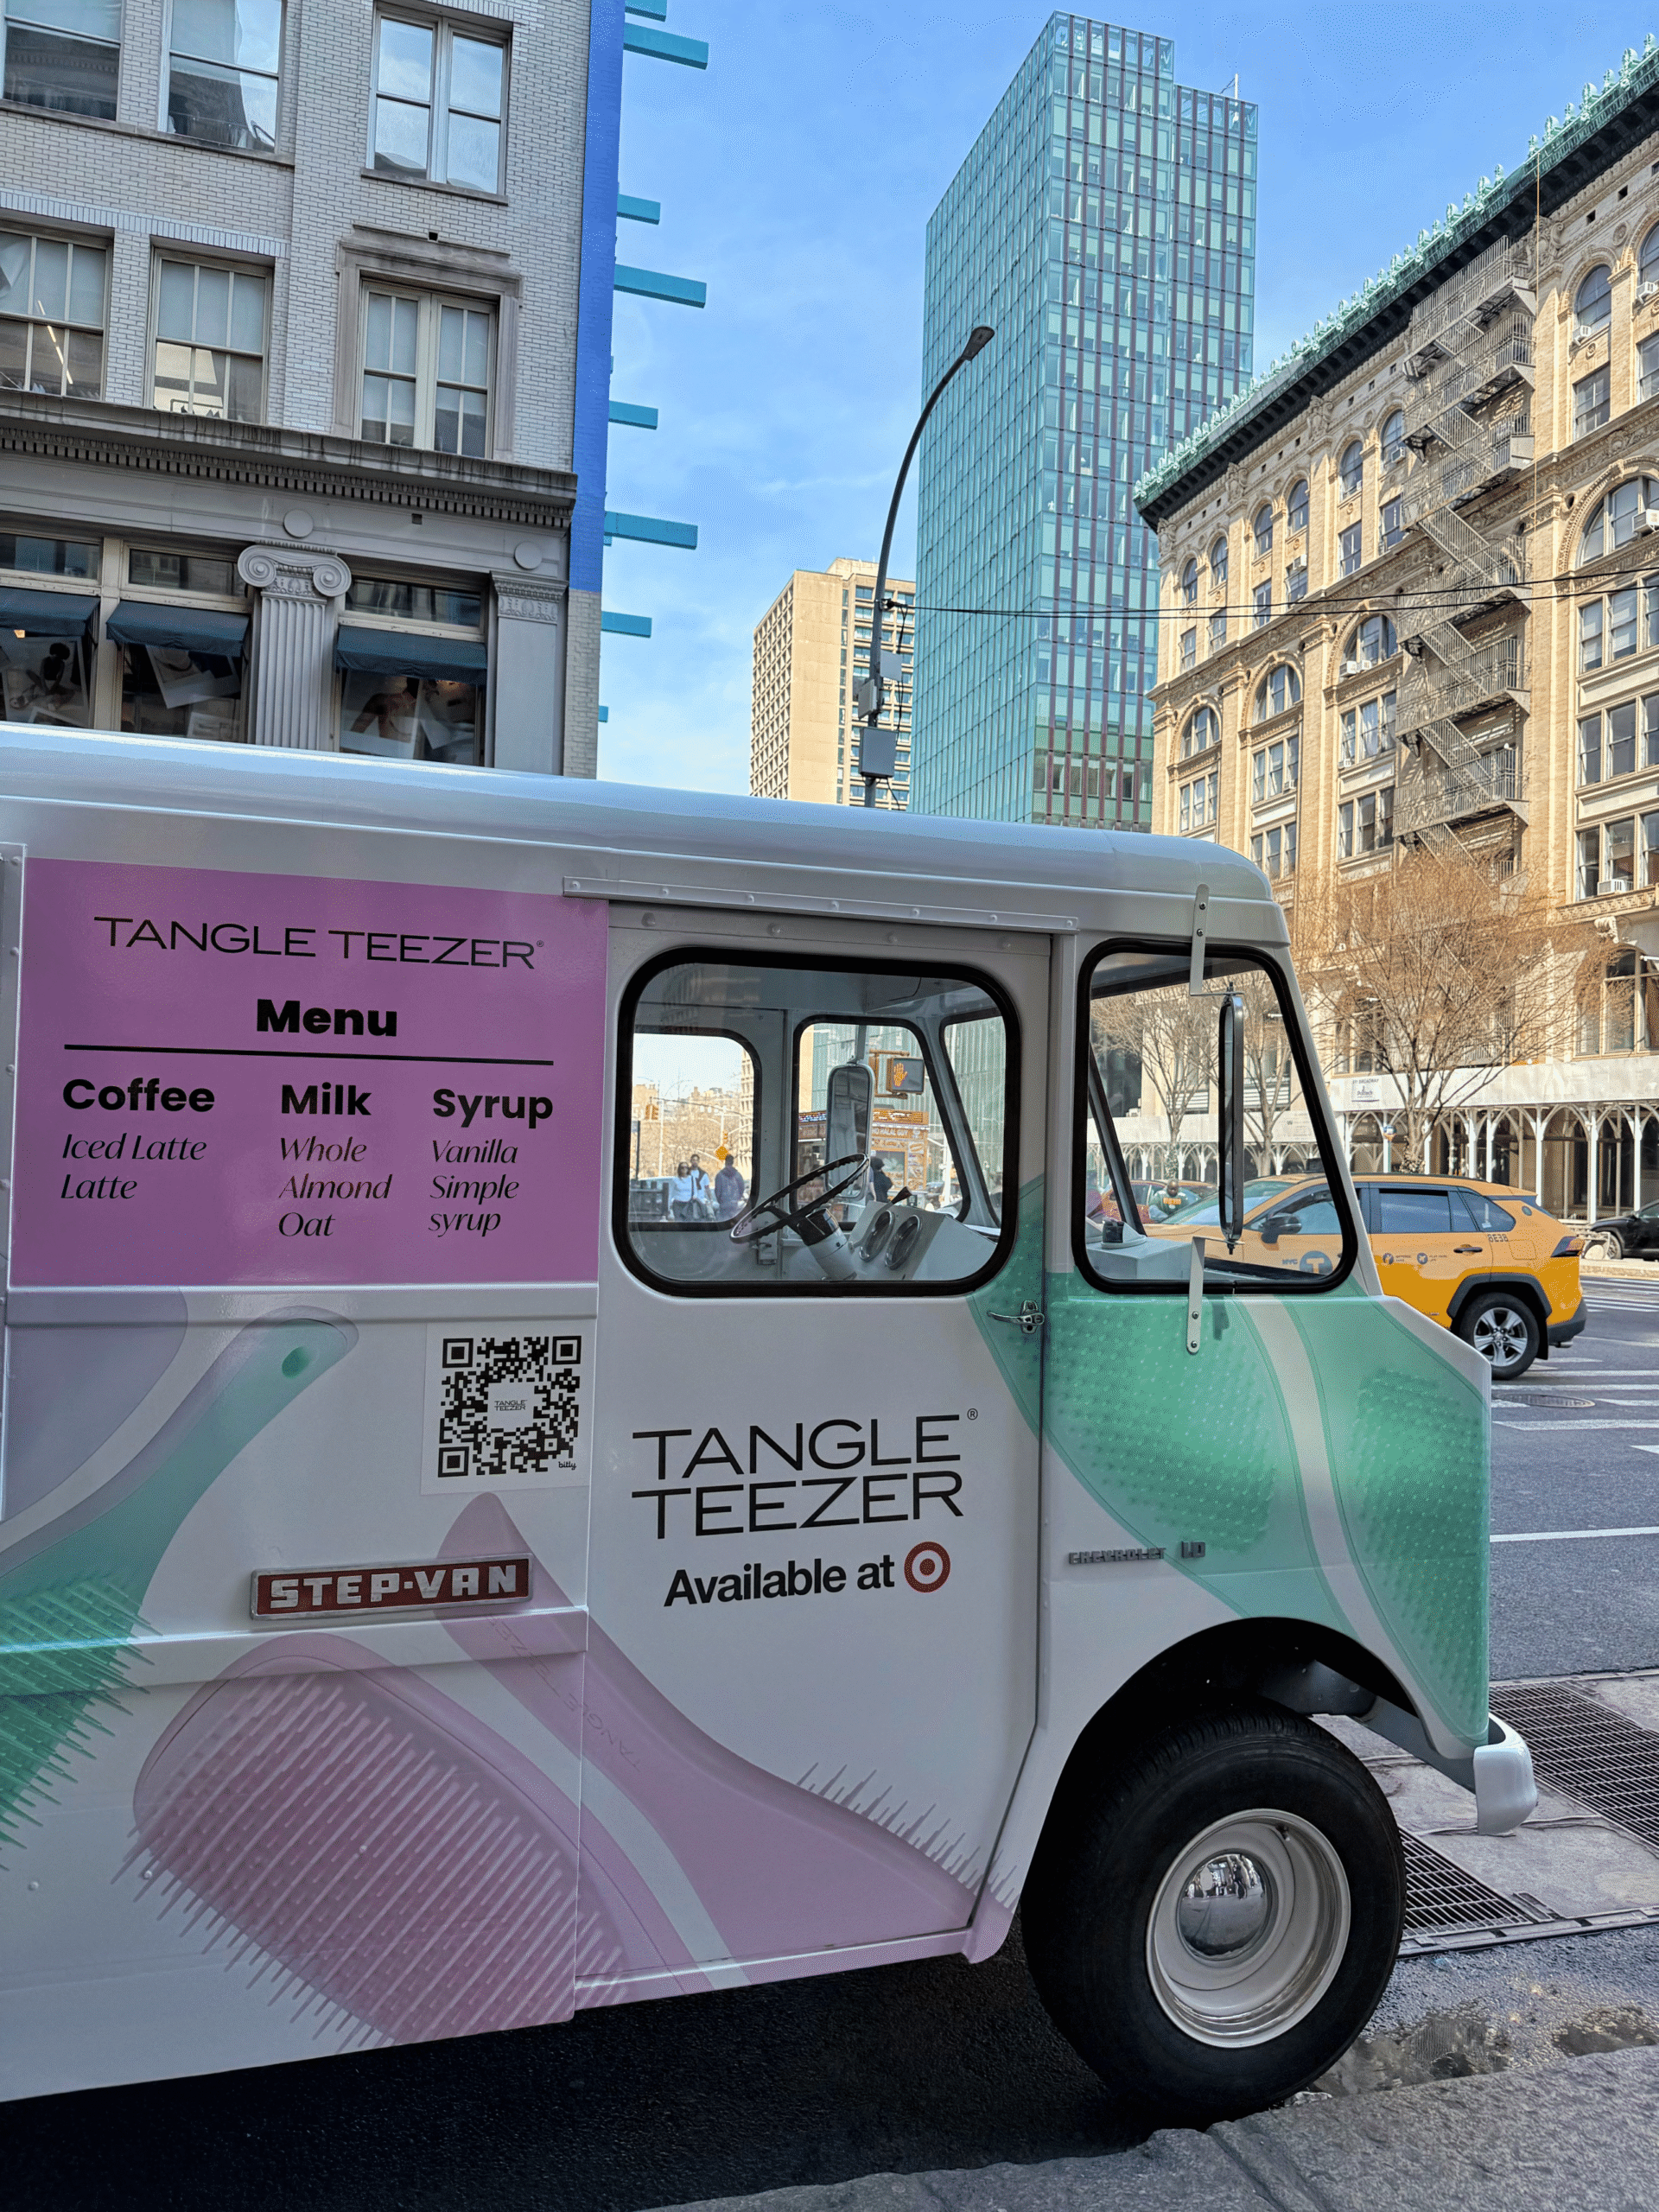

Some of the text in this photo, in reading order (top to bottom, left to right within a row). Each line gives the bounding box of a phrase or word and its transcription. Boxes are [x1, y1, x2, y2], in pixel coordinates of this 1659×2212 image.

[94, 916, 316, 957] TANGLE
[257, 998, 397, 1037] Menu
[62, 1077, 215, 1113] Coffee
[281, 1081, 372, 1116] Milk
[433, 1088, 554, 1129] Syrup
[61, 1132, 207, 1160] Iced Latte
[280, 1135, 367, 1162] Whole
[432, 1138, 518, 1164] Vanilla
[60, 1173, 138, 1200] Latte
[278, 1173, 393, 1199] Almond
[429, 1173, 520, 1205] Simple
[278, 1211, 336, 1237] Oat
[428, 1213, 501, 1238] syrup
[557, 1460, 577, 1471] bitly
[632, 1470, 964, 1540] TEEZER
[1069, 1548, 1166, 1565] CHEVROLET
[664, 1554, 895, 1607] Available at
